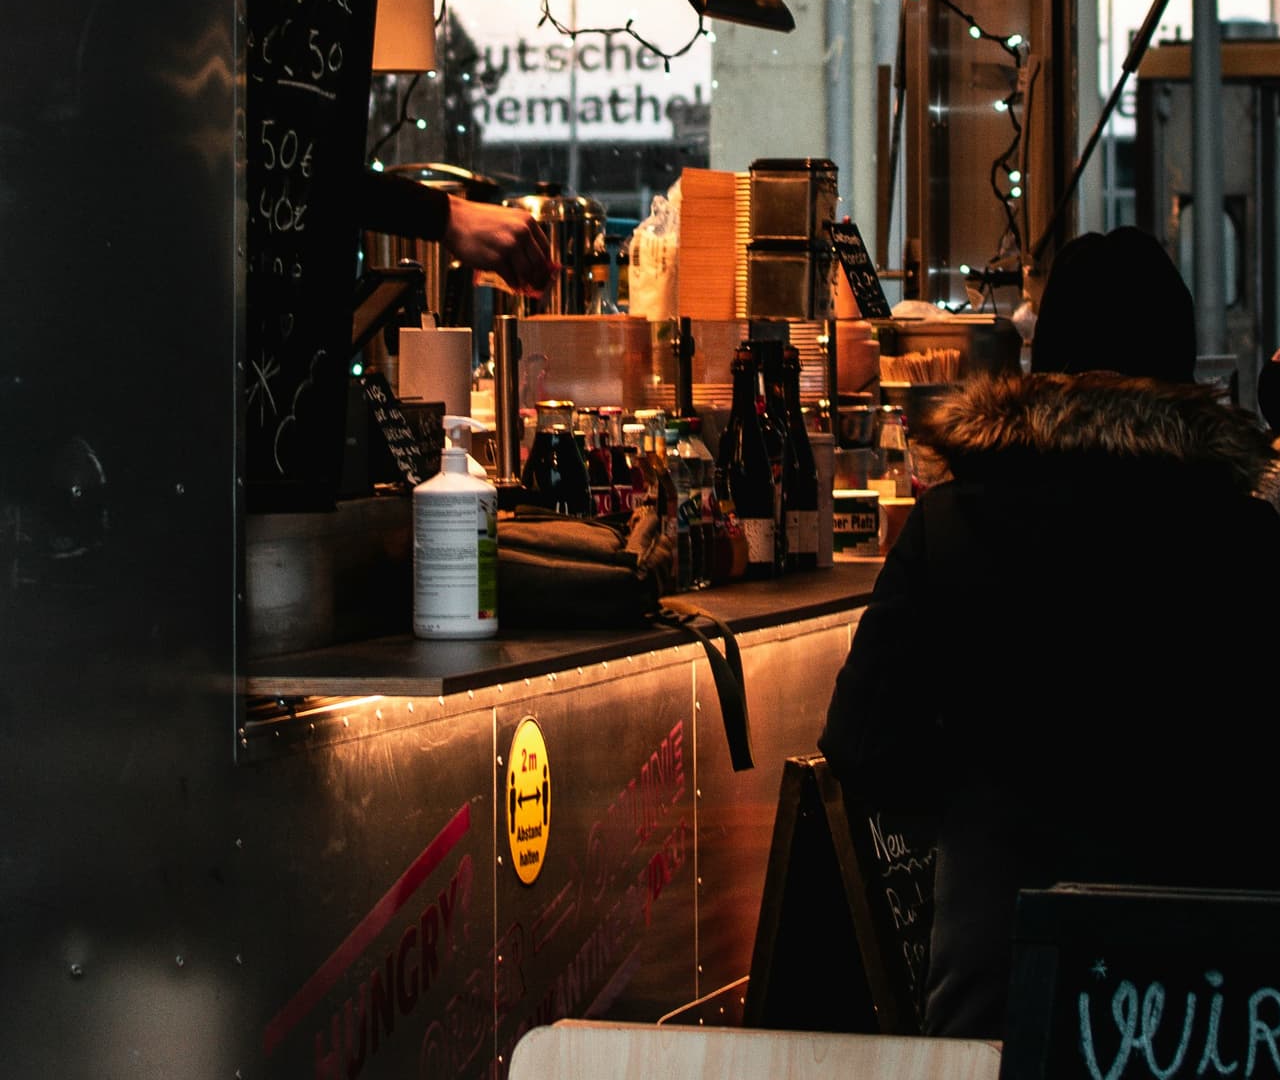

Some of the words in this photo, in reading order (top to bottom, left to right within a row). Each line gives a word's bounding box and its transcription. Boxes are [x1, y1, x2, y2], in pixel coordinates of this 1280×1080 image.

[483, 30, 663, 73] utsche
[521, 748, 527, 773] 2
[529, 752, 537, 771] m
[517, 823, 542, 842] Abstand
[520, 850, 540, 867] halten
